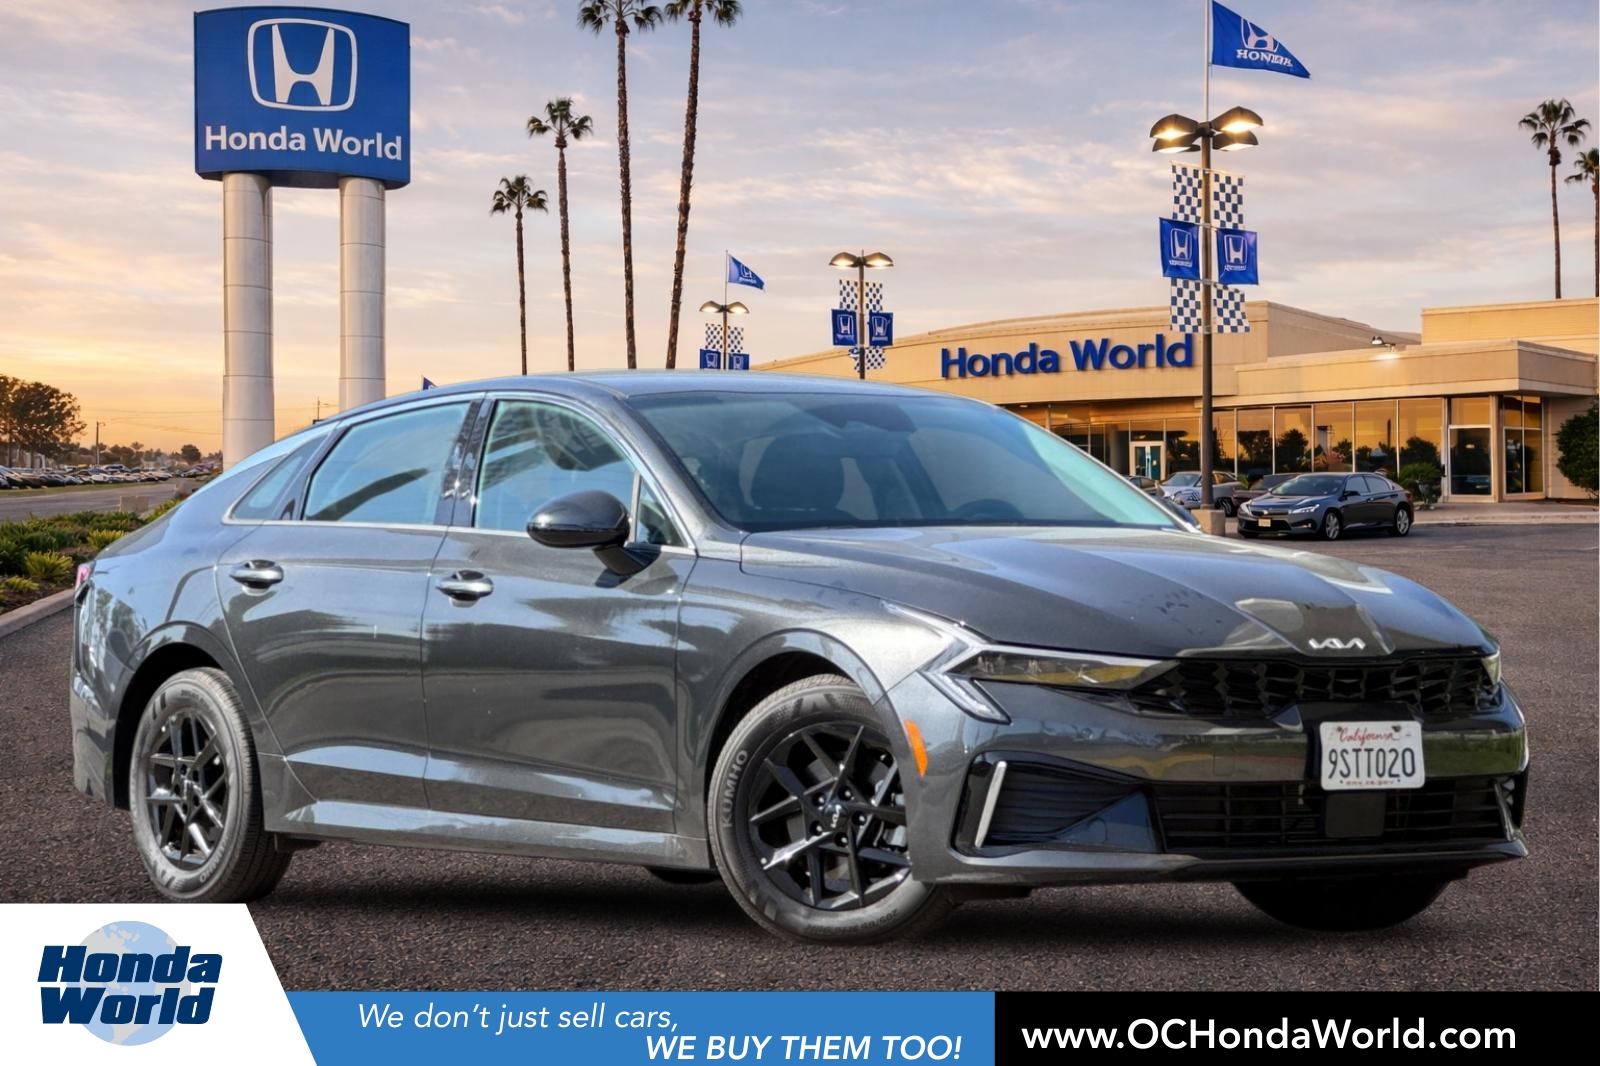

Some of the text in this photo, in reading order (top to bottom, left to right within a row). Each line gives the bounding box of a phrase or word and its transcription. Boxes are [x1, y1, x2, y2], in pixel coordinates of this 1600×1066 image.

[205, 125, 402, 161] Honda World
[941, 333, 1195, 378] Honda World
[1337, 727, 1400, 746] California
[1328, 747, 1416, 779] 9STT020
[719, 750, 749, 828] KUMHO
